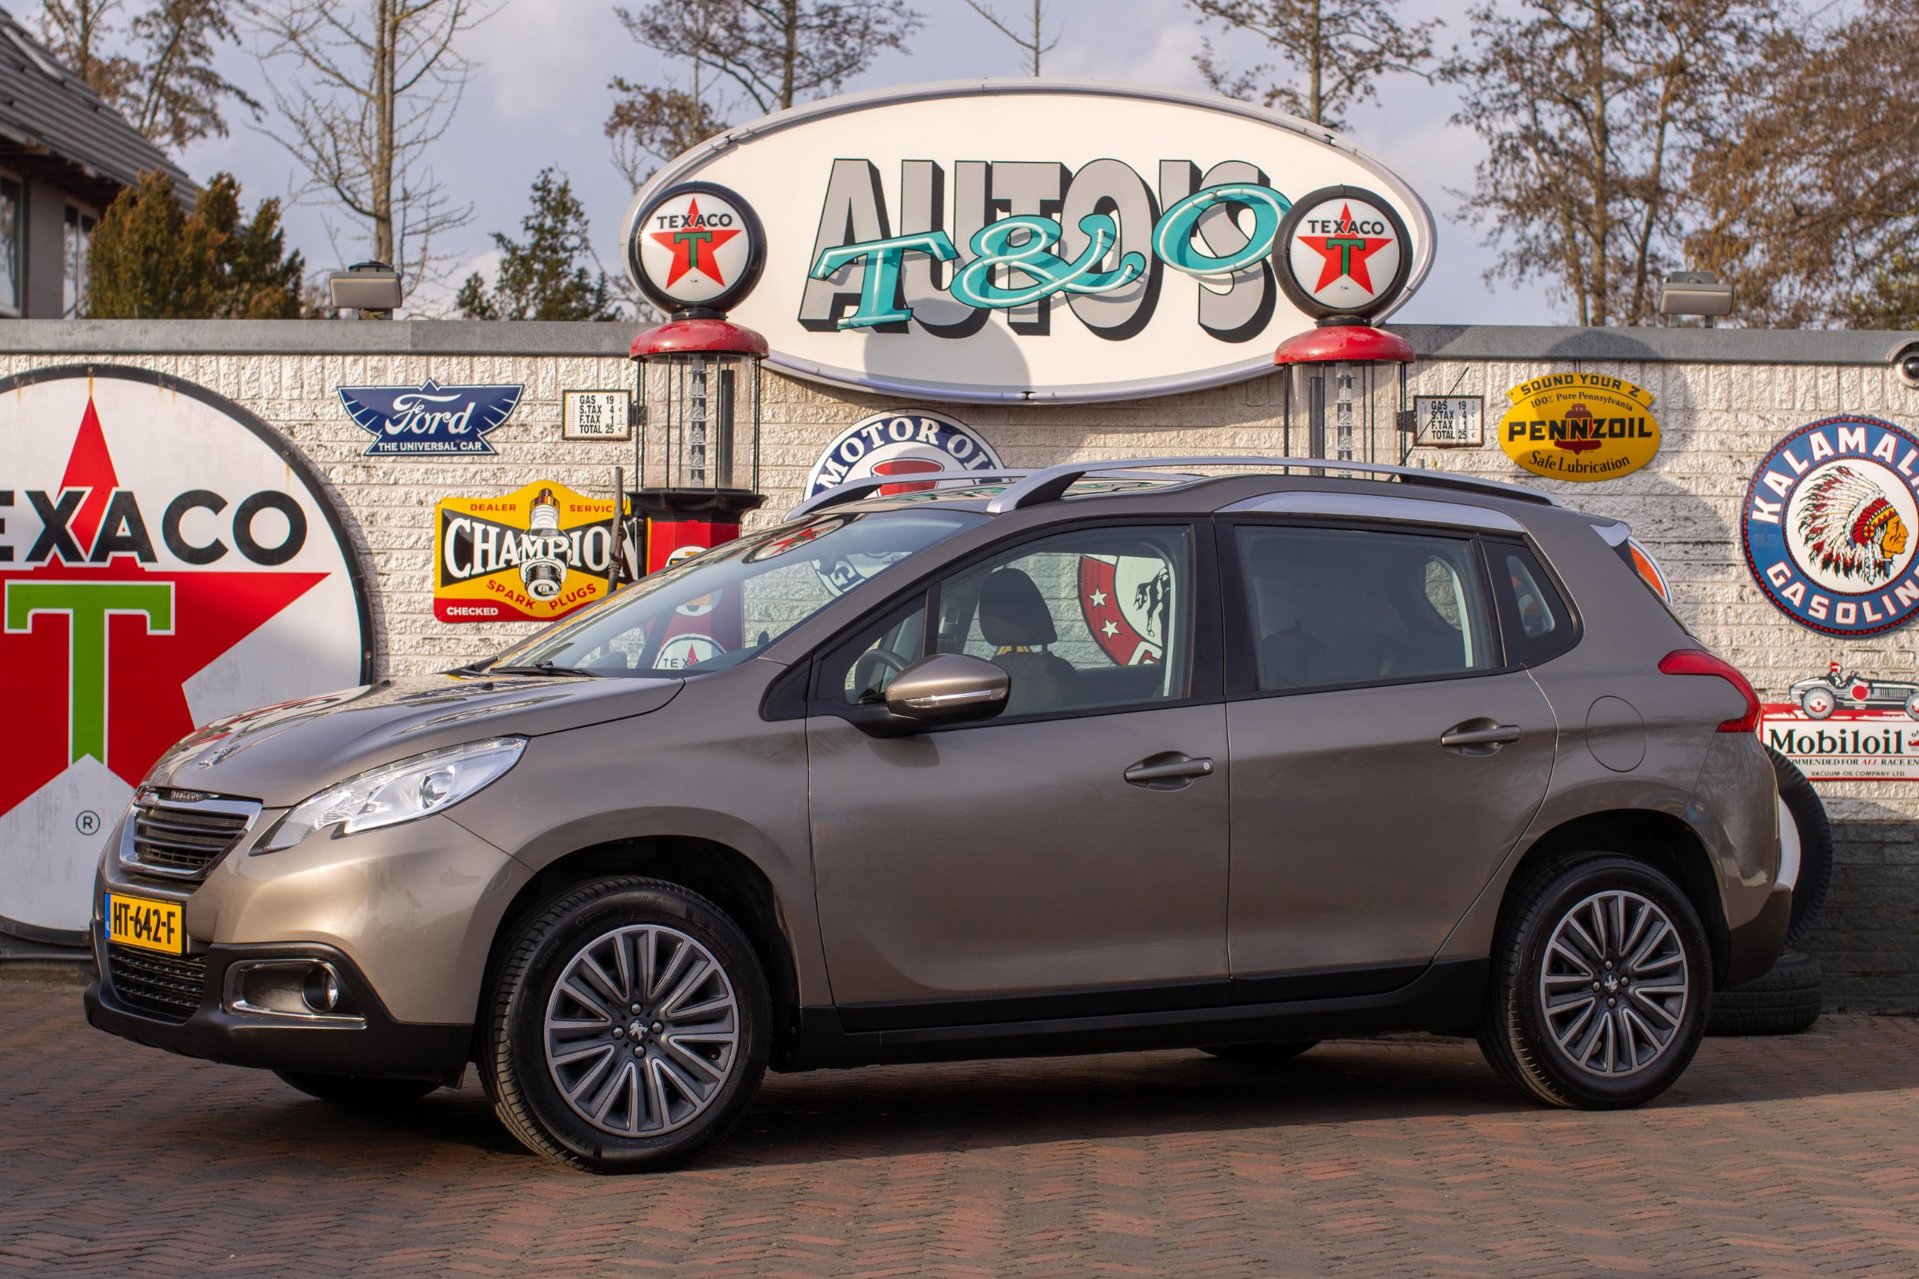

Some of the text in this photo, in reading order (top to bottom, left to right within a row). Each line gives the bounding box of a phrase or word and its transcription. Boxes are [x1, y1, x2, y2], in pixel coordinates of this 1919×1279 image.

[656, 213, 733, 230] TEXACO
[1307, 219, 1385, 236] TEXACO
[1520, 374, 1641, 398] SOUND YOUR Z
[579, 395, 615, 405] GAS 19
[1431, 400, 1467, 410] GAS 19
[1556, 392, 1577, 402] Pure
[1578, 391, 1633, 412] Pennsylvania
[384, 393, 477, 435] Ford
[579, 404, 615, 414] S.TAX 4
[1431, 410, 1467, 420] S.TAX 4
[579, 414, 615, 424] F.TAX 1
[1431, 420, 1467, 430] F.TAX 1
[579, 424, 615, 434] TOTAL 25
[1431, 430, 1468, 440] TOTAL 25
[1508, 417, 1653, 442] PENNZOIL
[377, 440, 483, 451] THE UNIVERSAL CAR
[815, 417, 996, 489] MOTOR OI
[1528, 450, 1631, 474] Safe Lubrication
[470, 503, 617, 513] DEALER SERVIC
[444, 517, 639, 581] CHAMPION
[486, 579, 597, 610] SPARK PLUGS
[1766, 561, 1919, 625] GASOLIN
[446, 606, 499, 616] CHECKED
[1769, 728, 1904, 755] Mobiloil
[1841, 758, 1859, 766] FOR
[1861, 758, 1879, 766] ALL
[1881, 758, 1905, 766] RACE
[113, 901, 176, 945] HT-642-F
